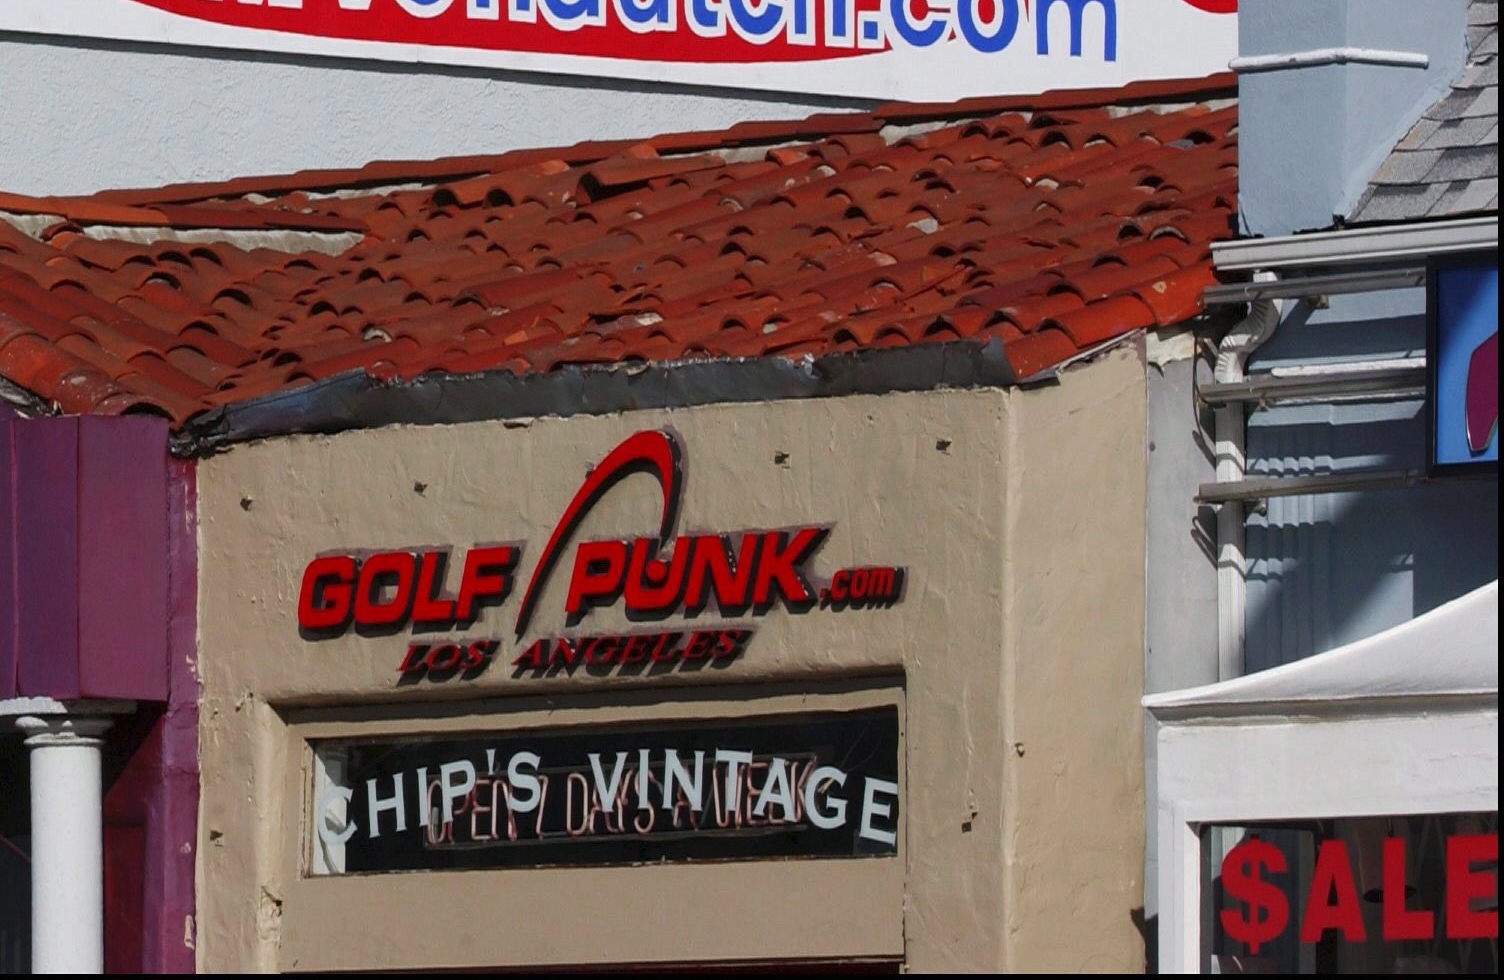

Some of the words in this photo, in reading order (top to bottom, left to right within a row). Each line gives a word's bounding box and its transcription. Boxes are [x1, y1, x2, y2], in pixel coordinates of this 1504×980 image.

[297, 545, 513, 630] GOLF
[397, 638, 493, 674] LOS
[510, 628, 746, 670] ANGELES
[317, 748, 543, 846] CHIP'S
[587, 747, 898, 846] VINTAGE
[1220, 834, 1500, 954] $ALE
